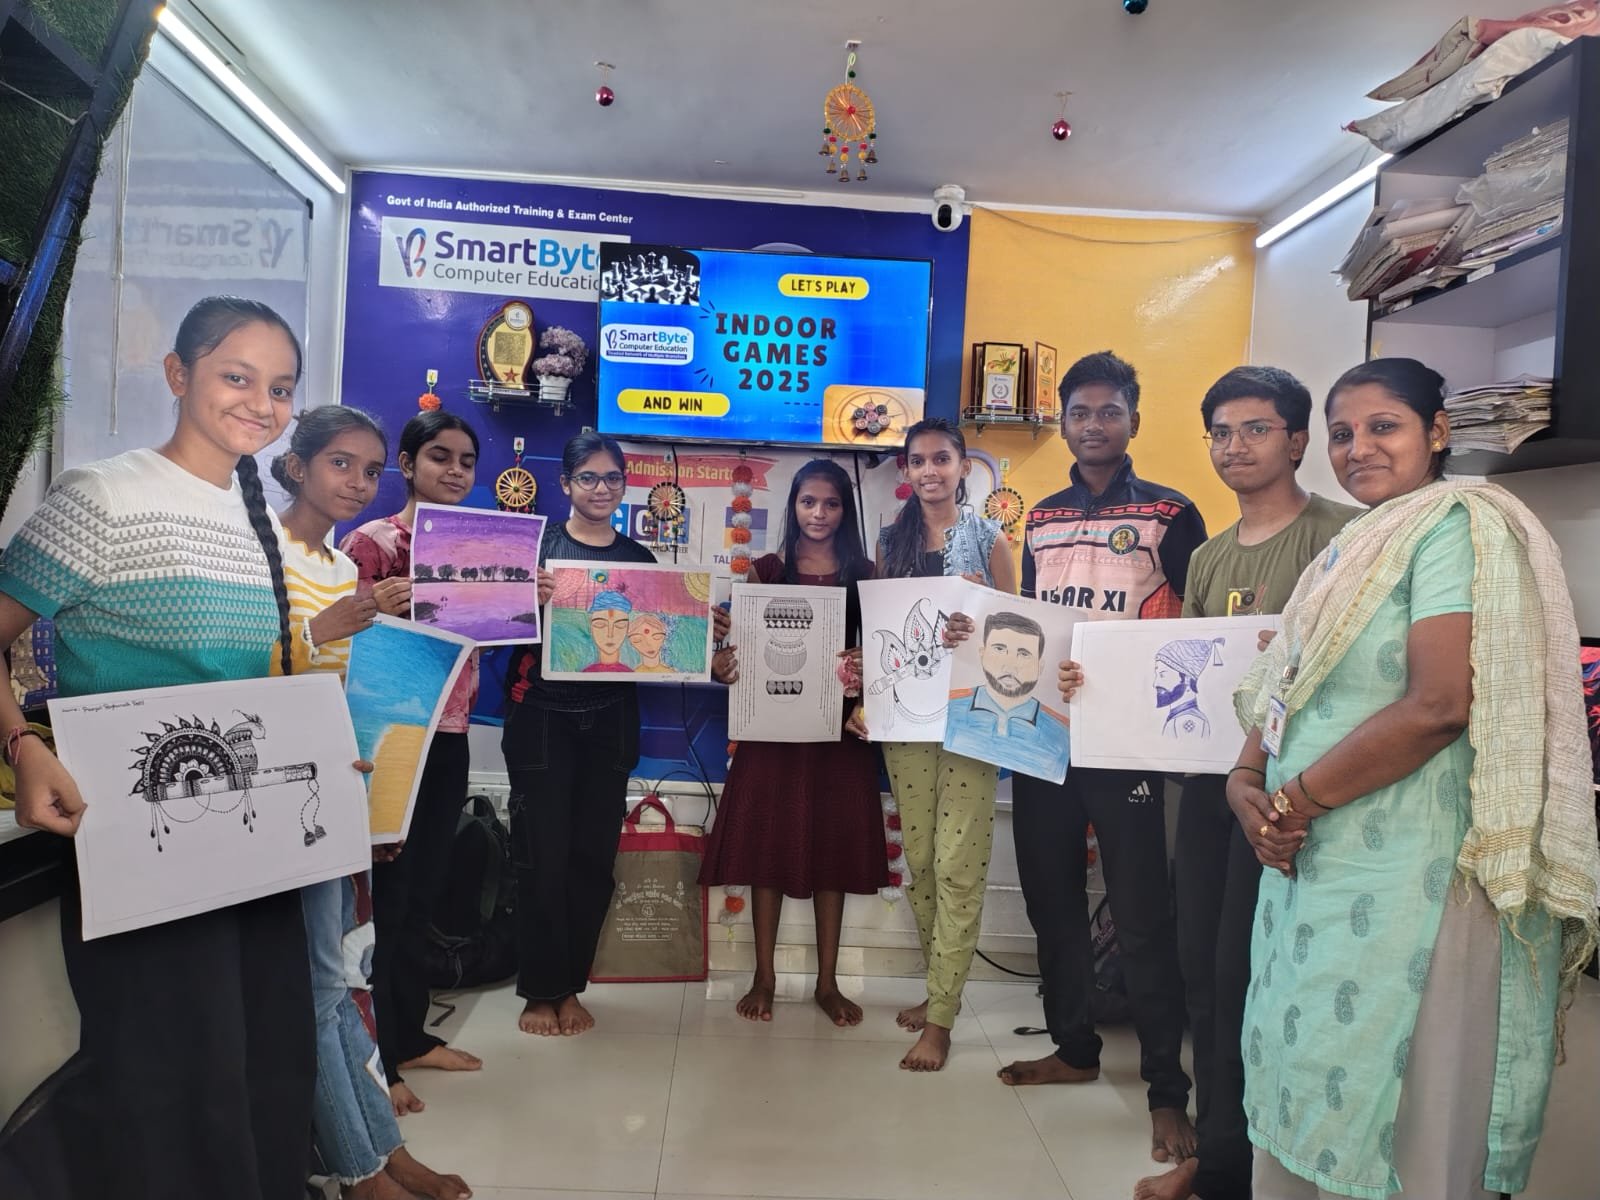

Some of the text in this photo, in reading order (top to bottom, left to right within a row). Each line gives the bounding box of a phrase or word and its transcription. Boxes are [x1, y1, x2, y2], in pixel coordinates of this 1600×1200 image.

[387, 195, 633, 224] Govt of India Authorized Training & Exam Center
[434, 230, 600, 275] SmartByt
[433, 263, 599, 291] Computer Educatio
[791, 279, 856, 294] LET'S PLAY
[619, 329, 688, 345] SmartByte
[715, 312, 837, 339] INDOOR
[618, 342, 688, 353] Computer Education
[723, 340, 828, 367] GAMES
[738, 368, 810, 392] 2025
[643, 396, 703, 412] AND WIN
[1100, 589, 1127, 612] XI
